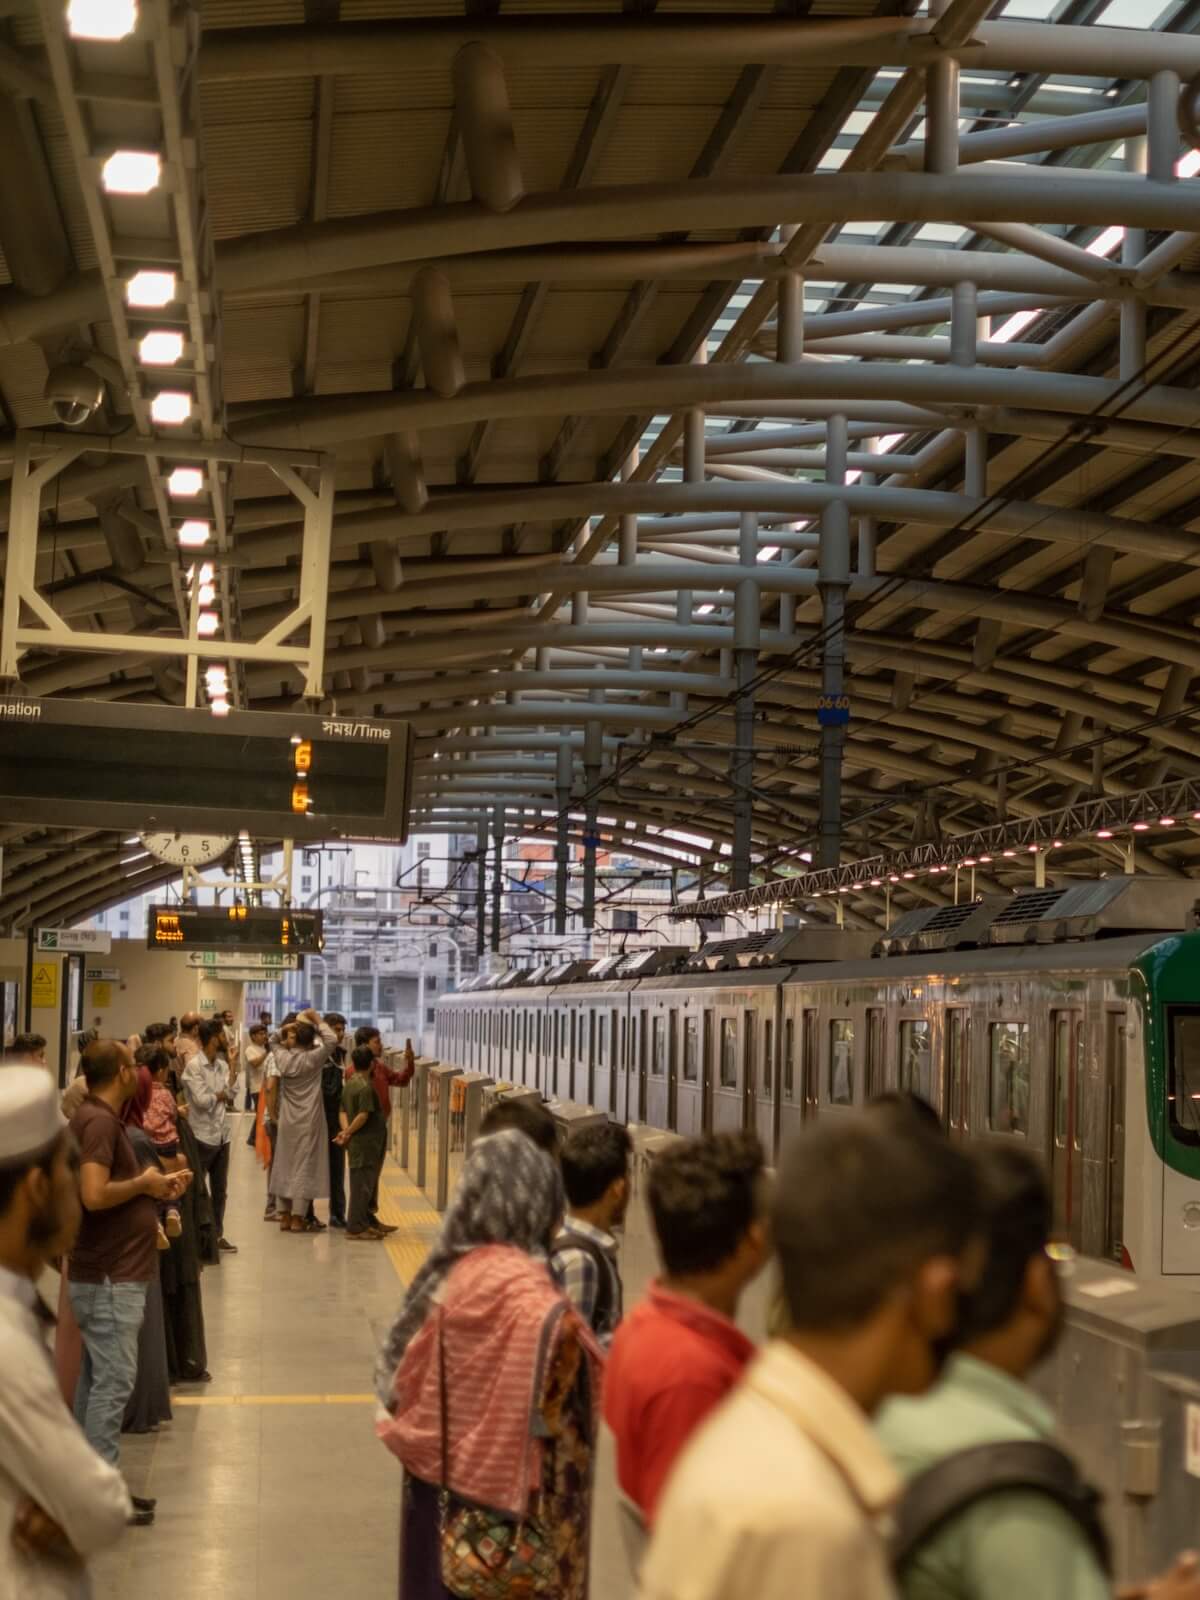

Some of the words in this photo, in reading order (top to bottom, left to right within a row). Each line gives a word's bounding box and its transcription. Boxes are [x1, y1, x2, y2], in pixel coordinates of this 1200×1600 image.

[163, 838, 172, 850] 7
[201, 840, 210, 851] 5
[181, 845, 189, 856] 6
